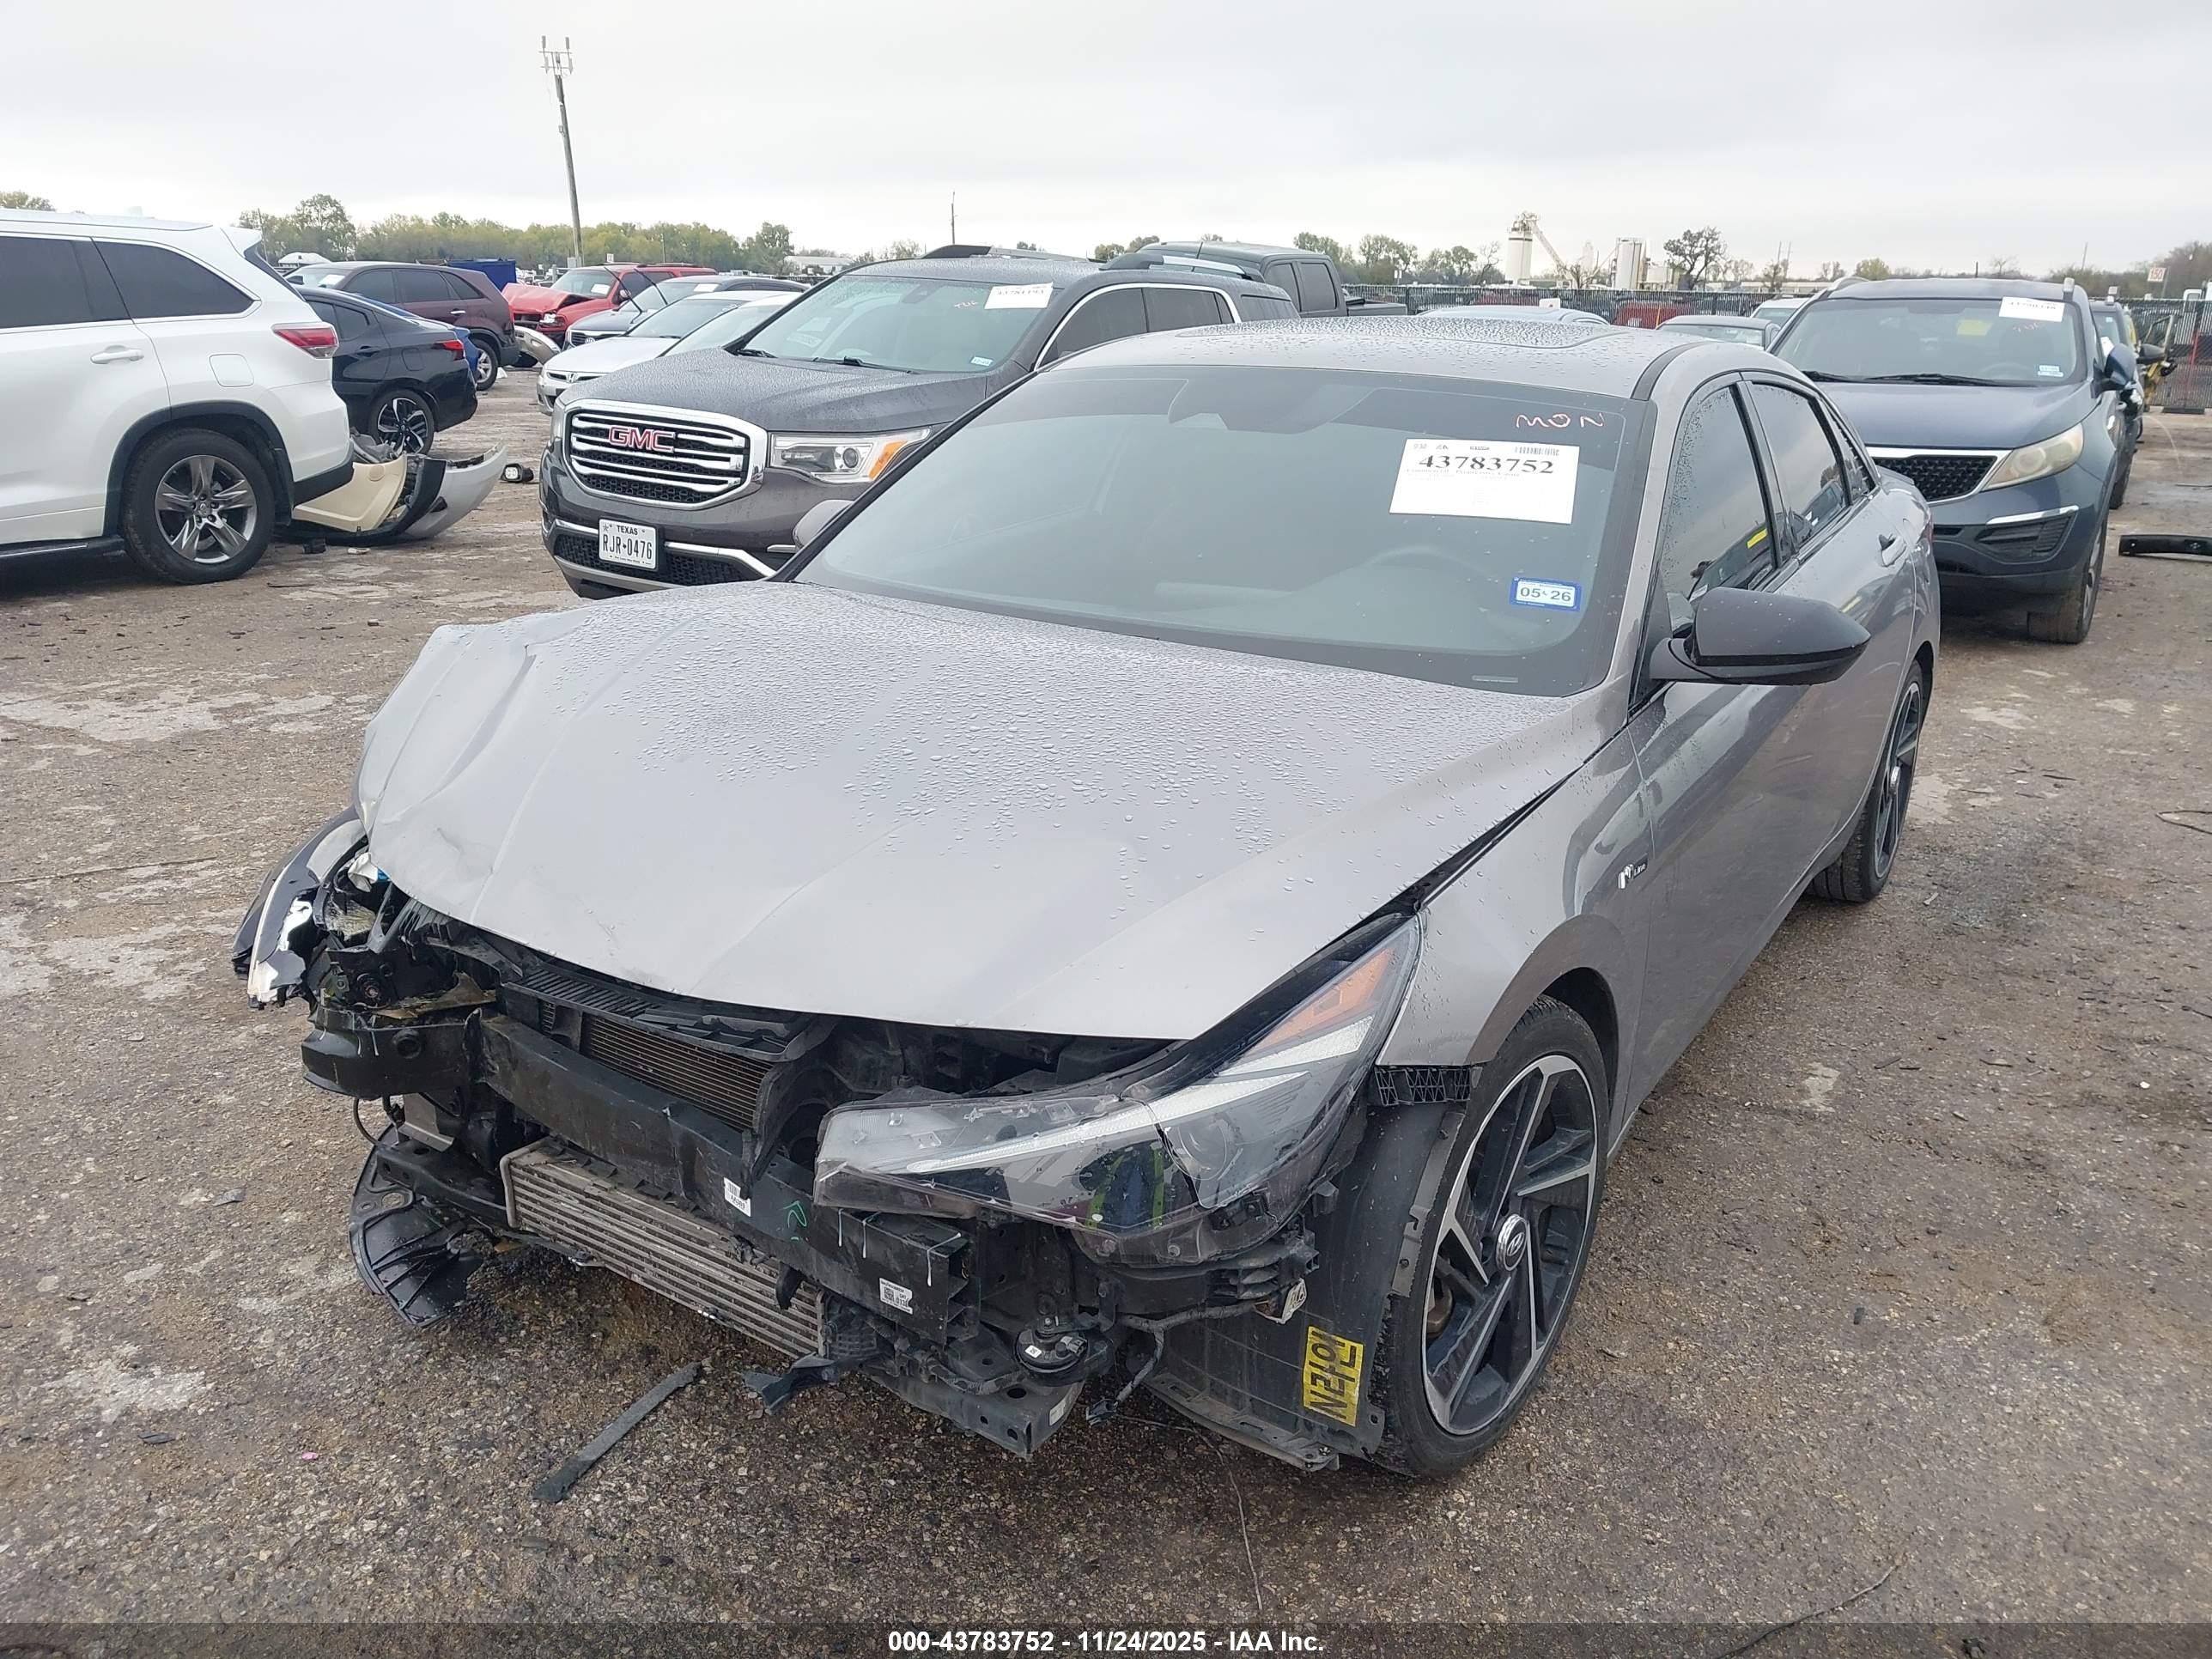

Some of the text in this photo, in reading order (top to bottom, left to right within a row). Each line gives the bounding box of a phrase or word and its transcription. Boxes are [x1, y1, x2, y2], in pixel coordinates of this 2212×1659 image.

[1516, 412, 1605, 428] MON
[609, 425, 676, 454] GMC
[1419, 454, 1554, 474] 43783752
[617, 525, 638, 536] TEXAS
